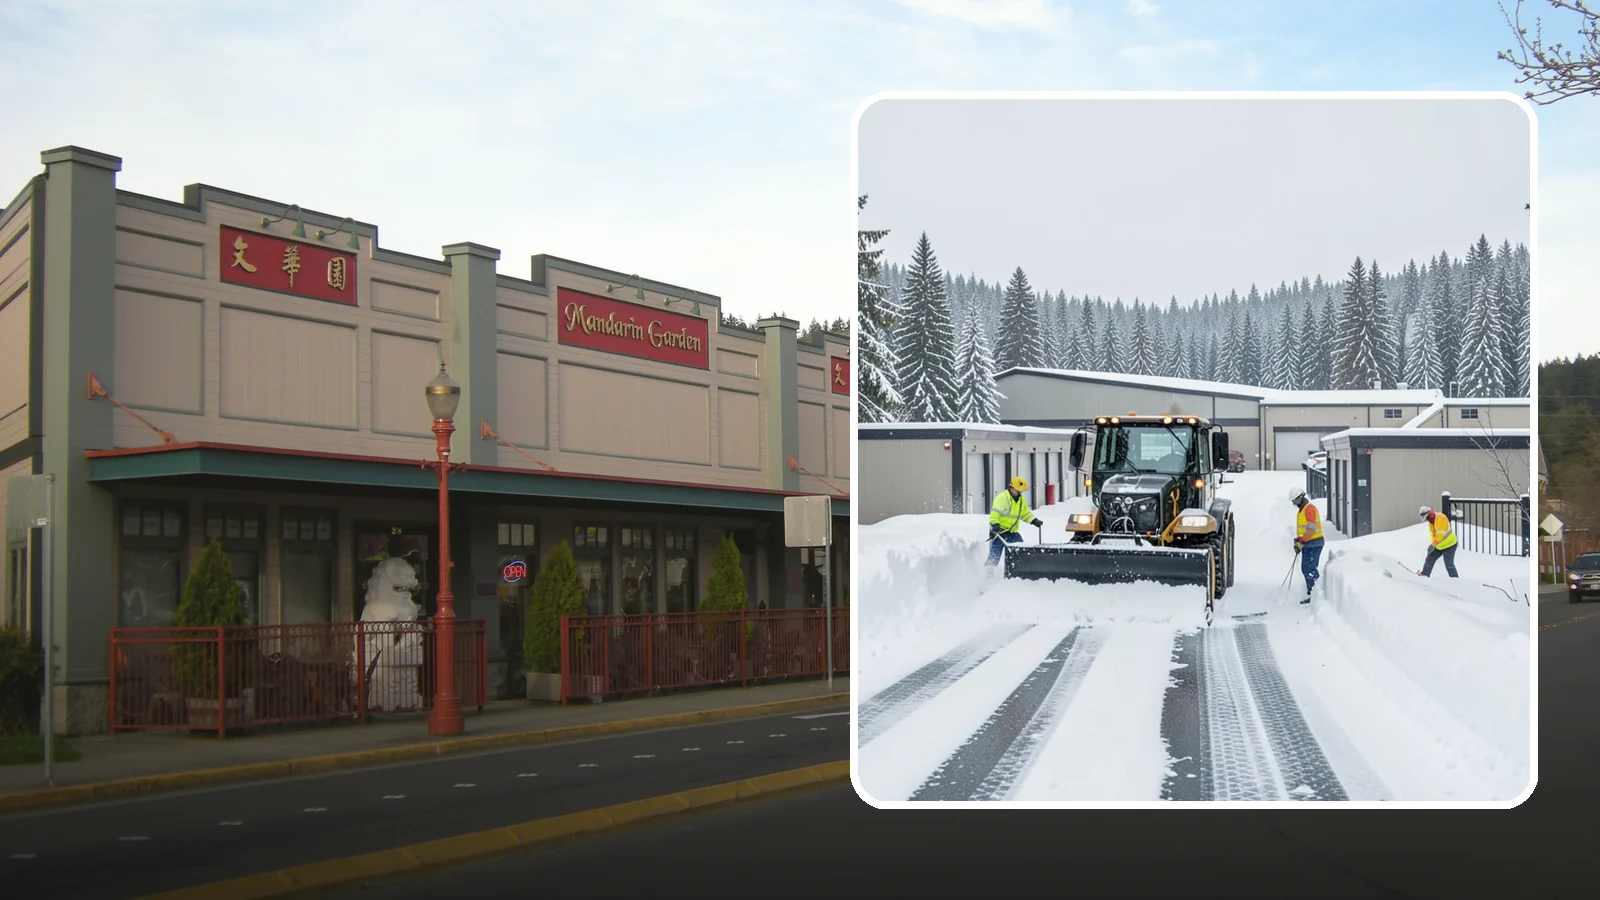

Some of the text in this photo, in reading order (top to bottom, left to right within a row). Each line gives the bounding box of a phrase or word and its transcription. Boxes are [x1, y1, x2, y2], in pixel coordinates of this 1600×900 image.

[230, 235, 346, 291] 文華園
[564, 302, 701, 352] Mandarin Garden
[503, 565, 527, 578] OPEN
